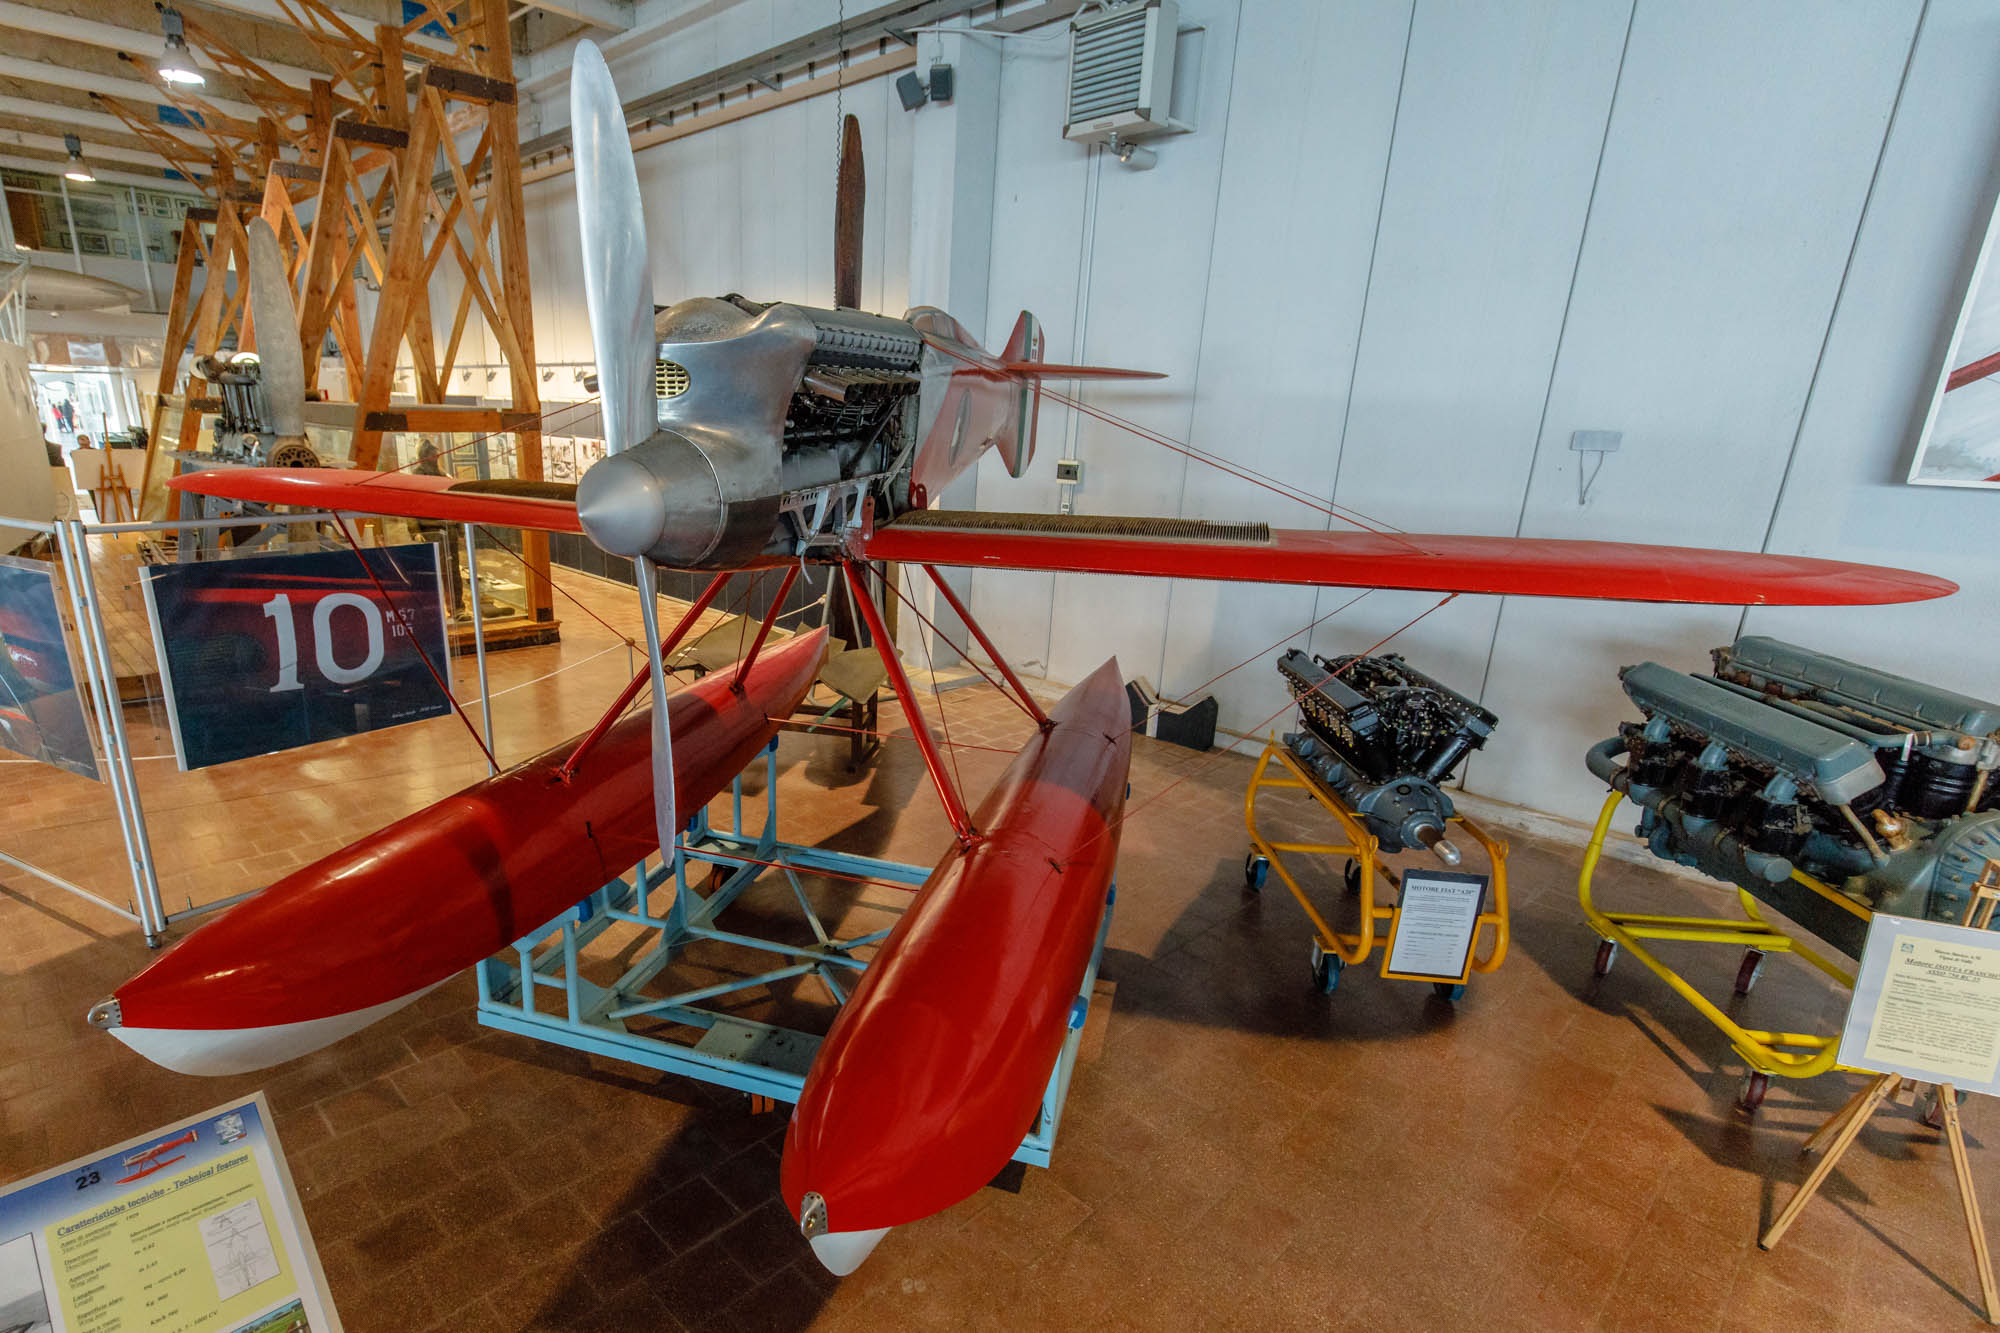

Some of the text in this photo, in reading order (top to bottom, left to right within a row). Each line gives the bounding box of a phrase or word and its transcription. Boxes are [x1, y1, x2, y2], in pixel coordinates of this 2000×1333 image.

[263, 592, 384, 693] 10
[57, 1205, 125, 1237] Caratteristiche
[128, 1187, 165, 1208] tecniche
[173, 1166, 214, 1190] Technical
[216, 1154, 248, 1172] features
[75, 1171, 100, 1191] 23
